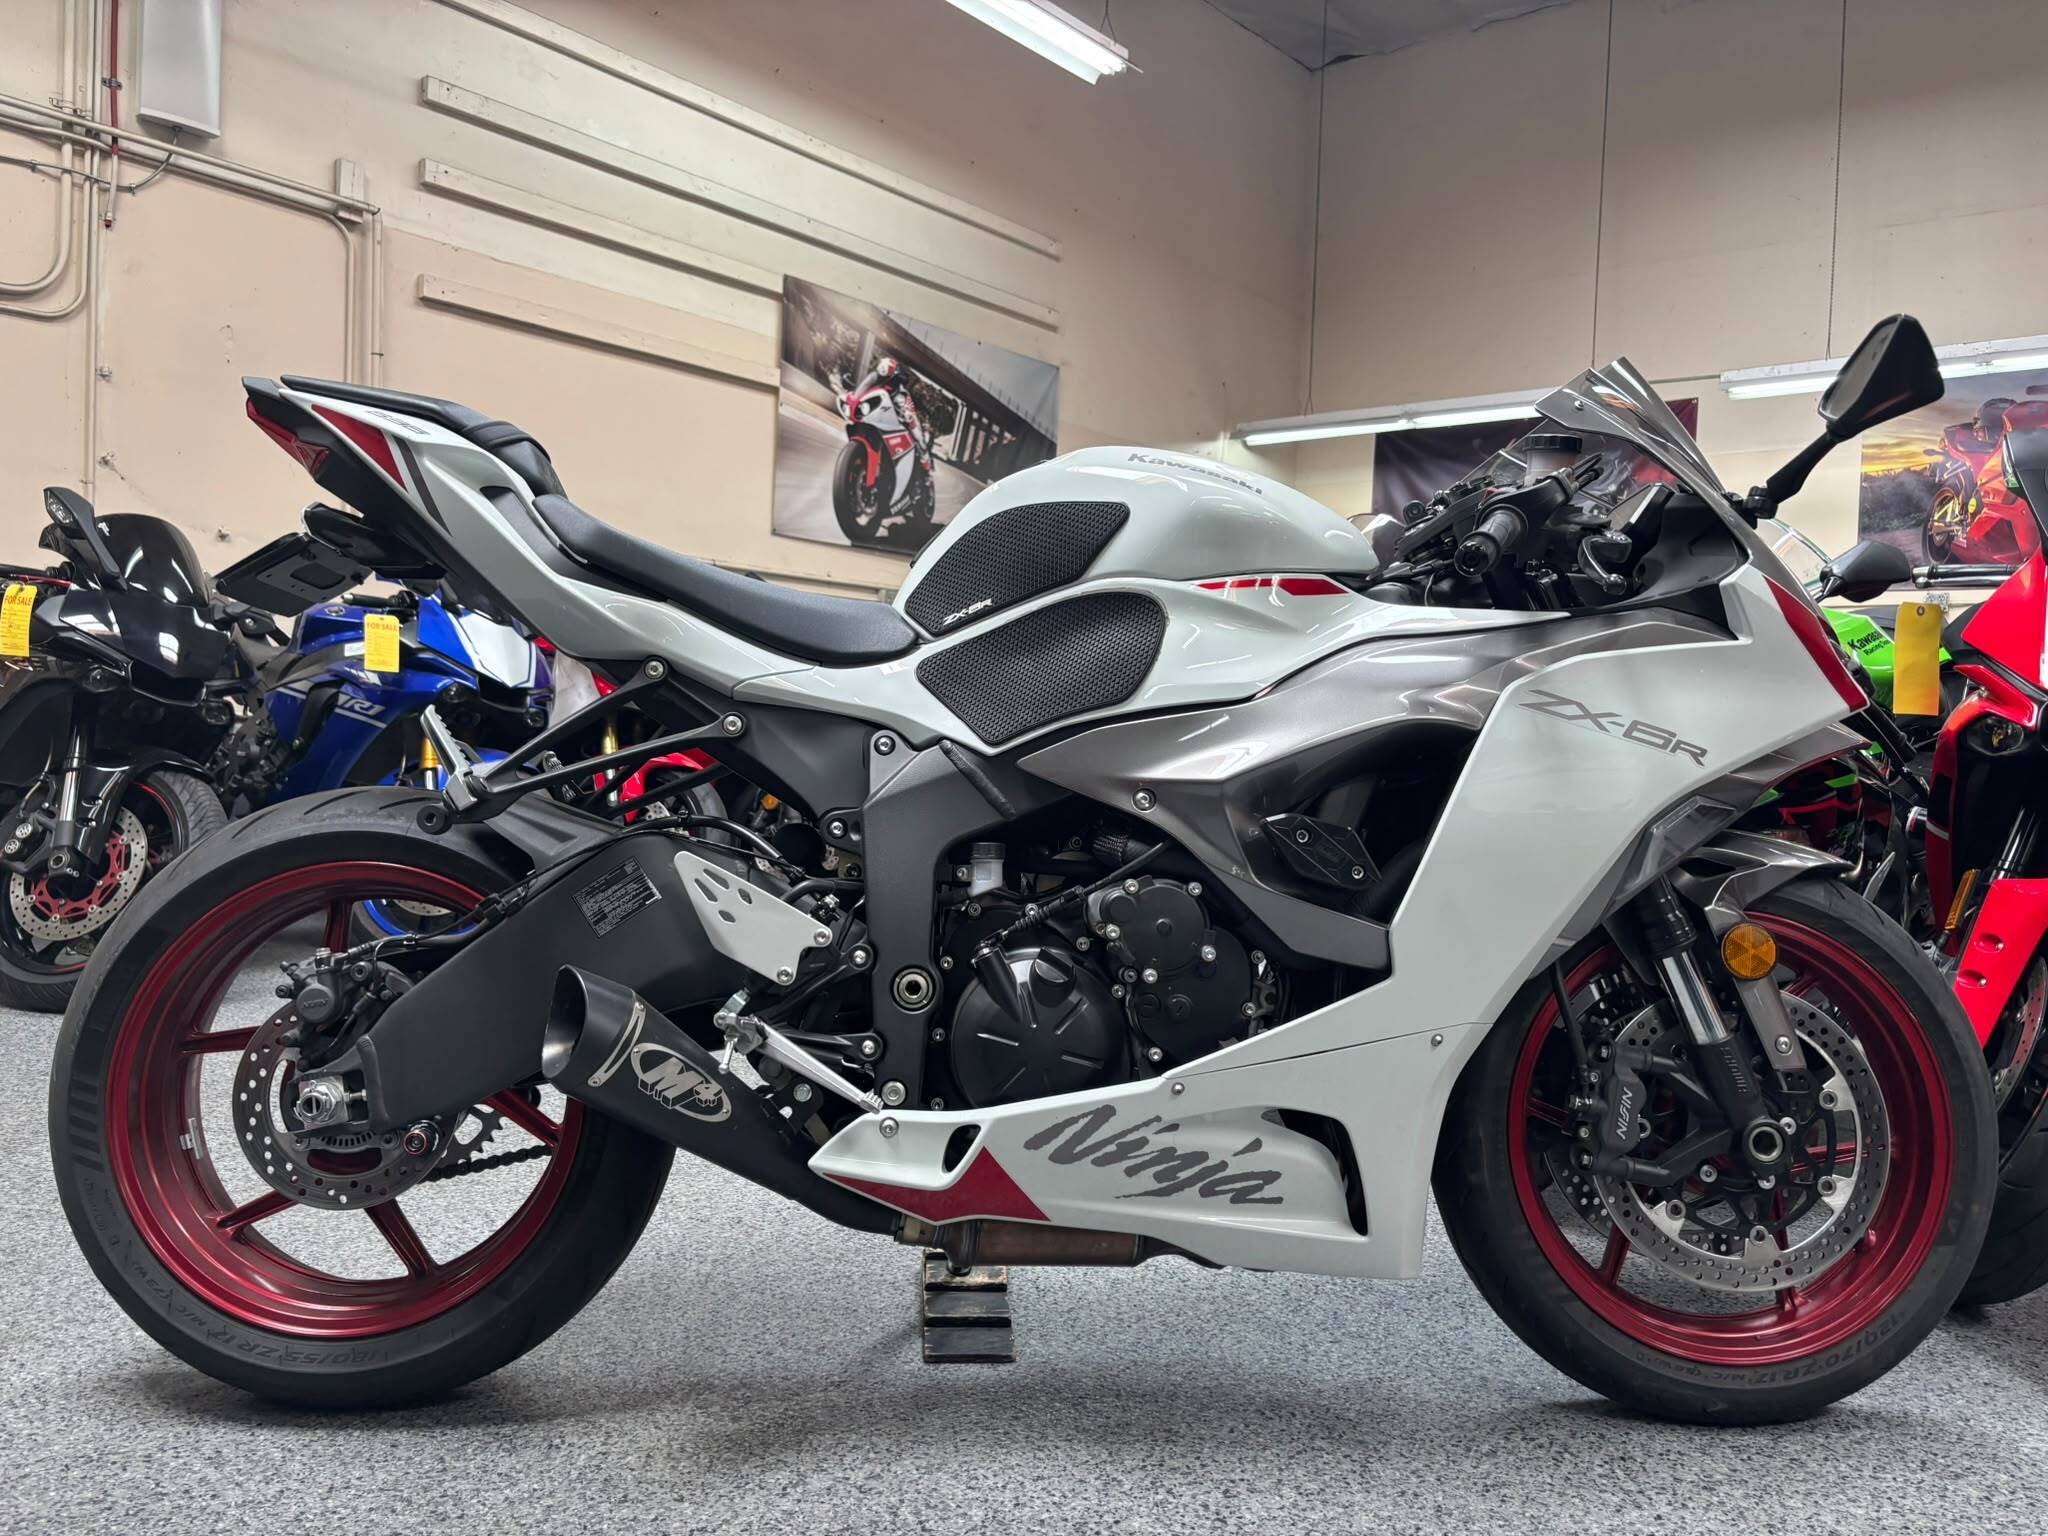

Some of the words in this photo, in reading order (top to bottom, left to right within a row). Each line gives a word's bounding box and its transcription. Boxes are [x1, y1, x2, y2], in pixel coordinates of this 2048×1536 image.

[1127, 453, 1263, 495] Kawasaki
[5, 595, 16, 605] FOR
[17, 597, 32, 606] SALE
[1518, 689, 1708, 767] ZX-6R
[1023, 1104, 1283, 1205] Ninja
